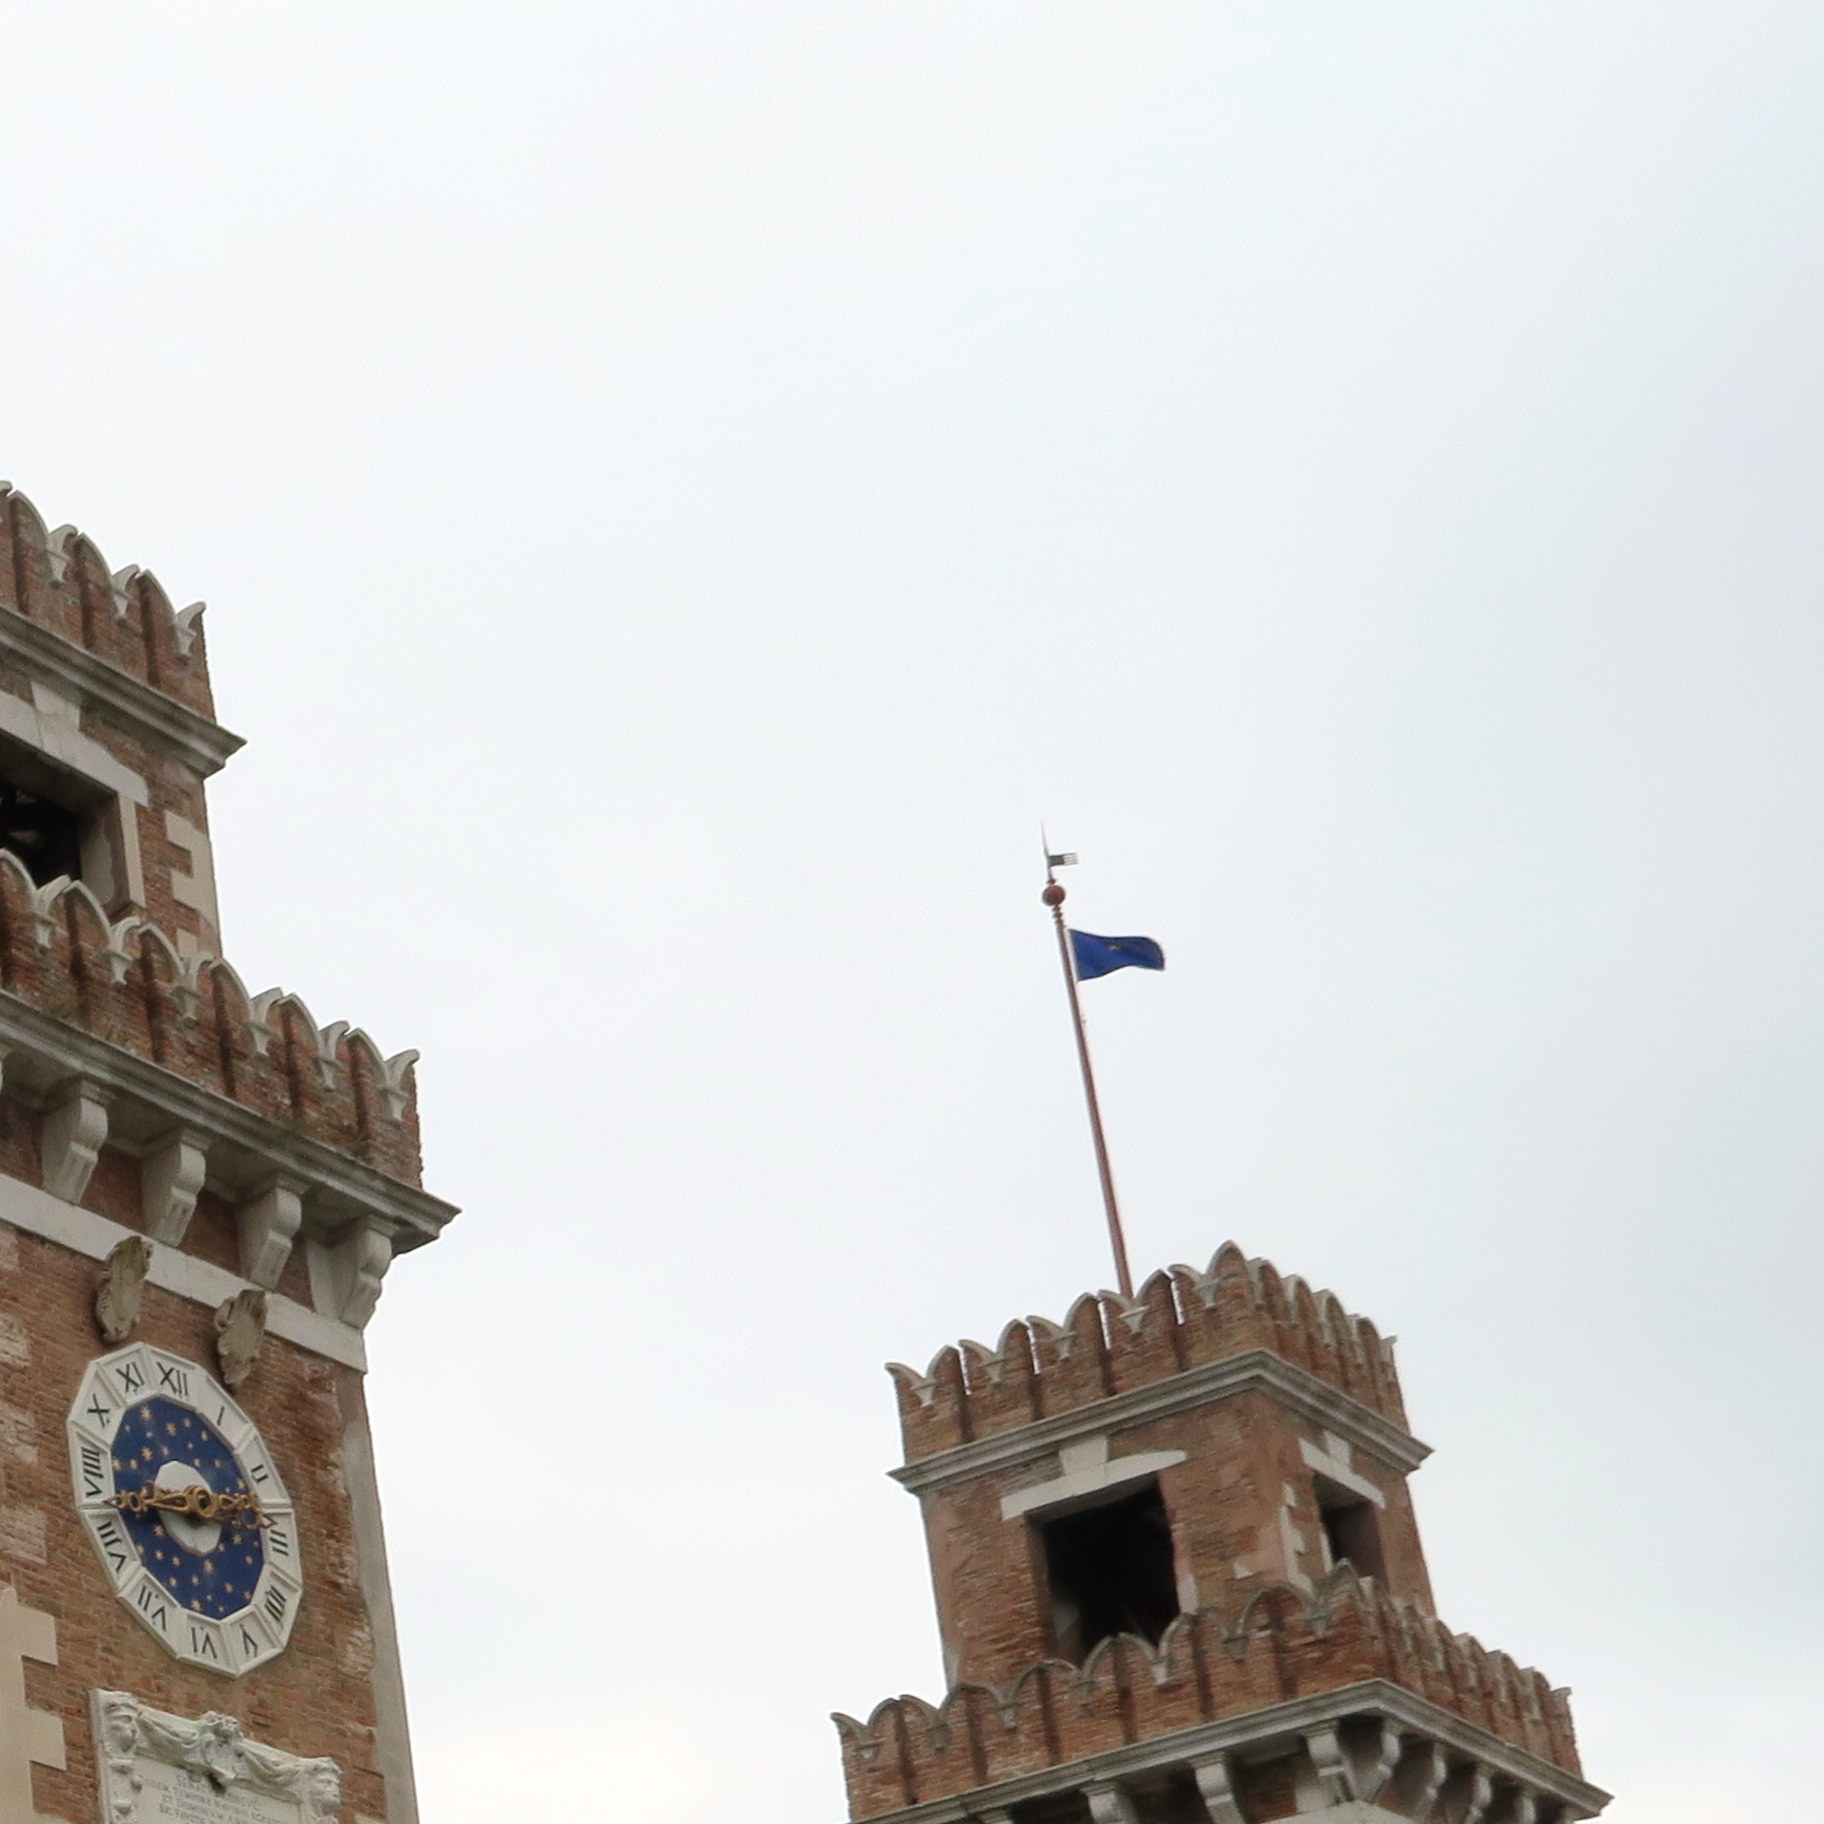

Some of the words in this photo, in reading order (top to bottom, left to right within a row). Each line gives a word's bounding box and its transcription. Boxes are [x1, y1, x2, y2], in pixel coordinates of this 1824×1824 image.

[156, 1362, 188, 1397] XII
[87, 1393, 110, 1426] X
[136, 1584, 168, 1632] VII
